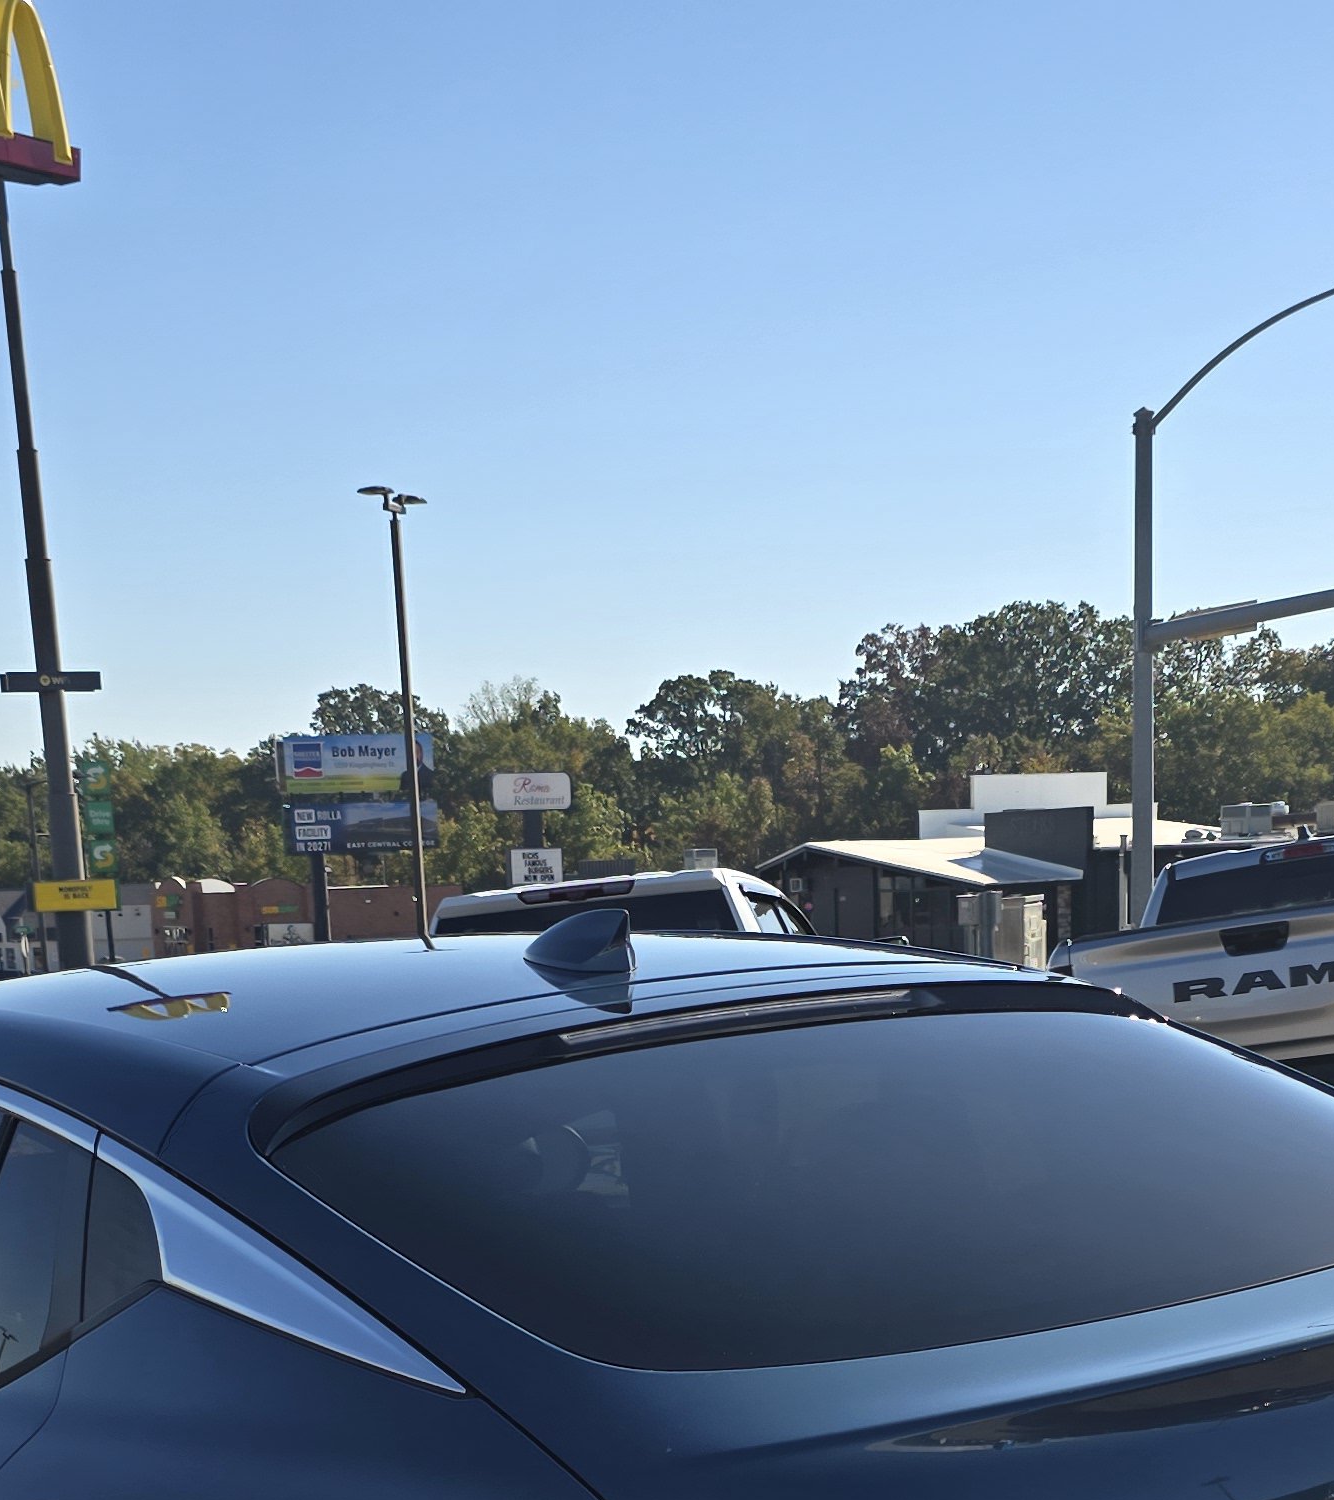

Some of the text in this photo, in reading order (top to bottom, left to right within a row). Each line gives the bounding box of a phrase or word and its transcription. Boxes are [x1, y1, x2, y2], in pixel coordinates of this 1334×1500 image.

[332, 745, 396, 759] Bob Mayer
[514, 796, 564, 806] Restaurant
[89, 810, 111, 818] Drive
[297, 811, 342, 821] NEW ROLLA
[298, 828, 328, 838] FACILITY
[307, 841, 331, 851] 2027!
